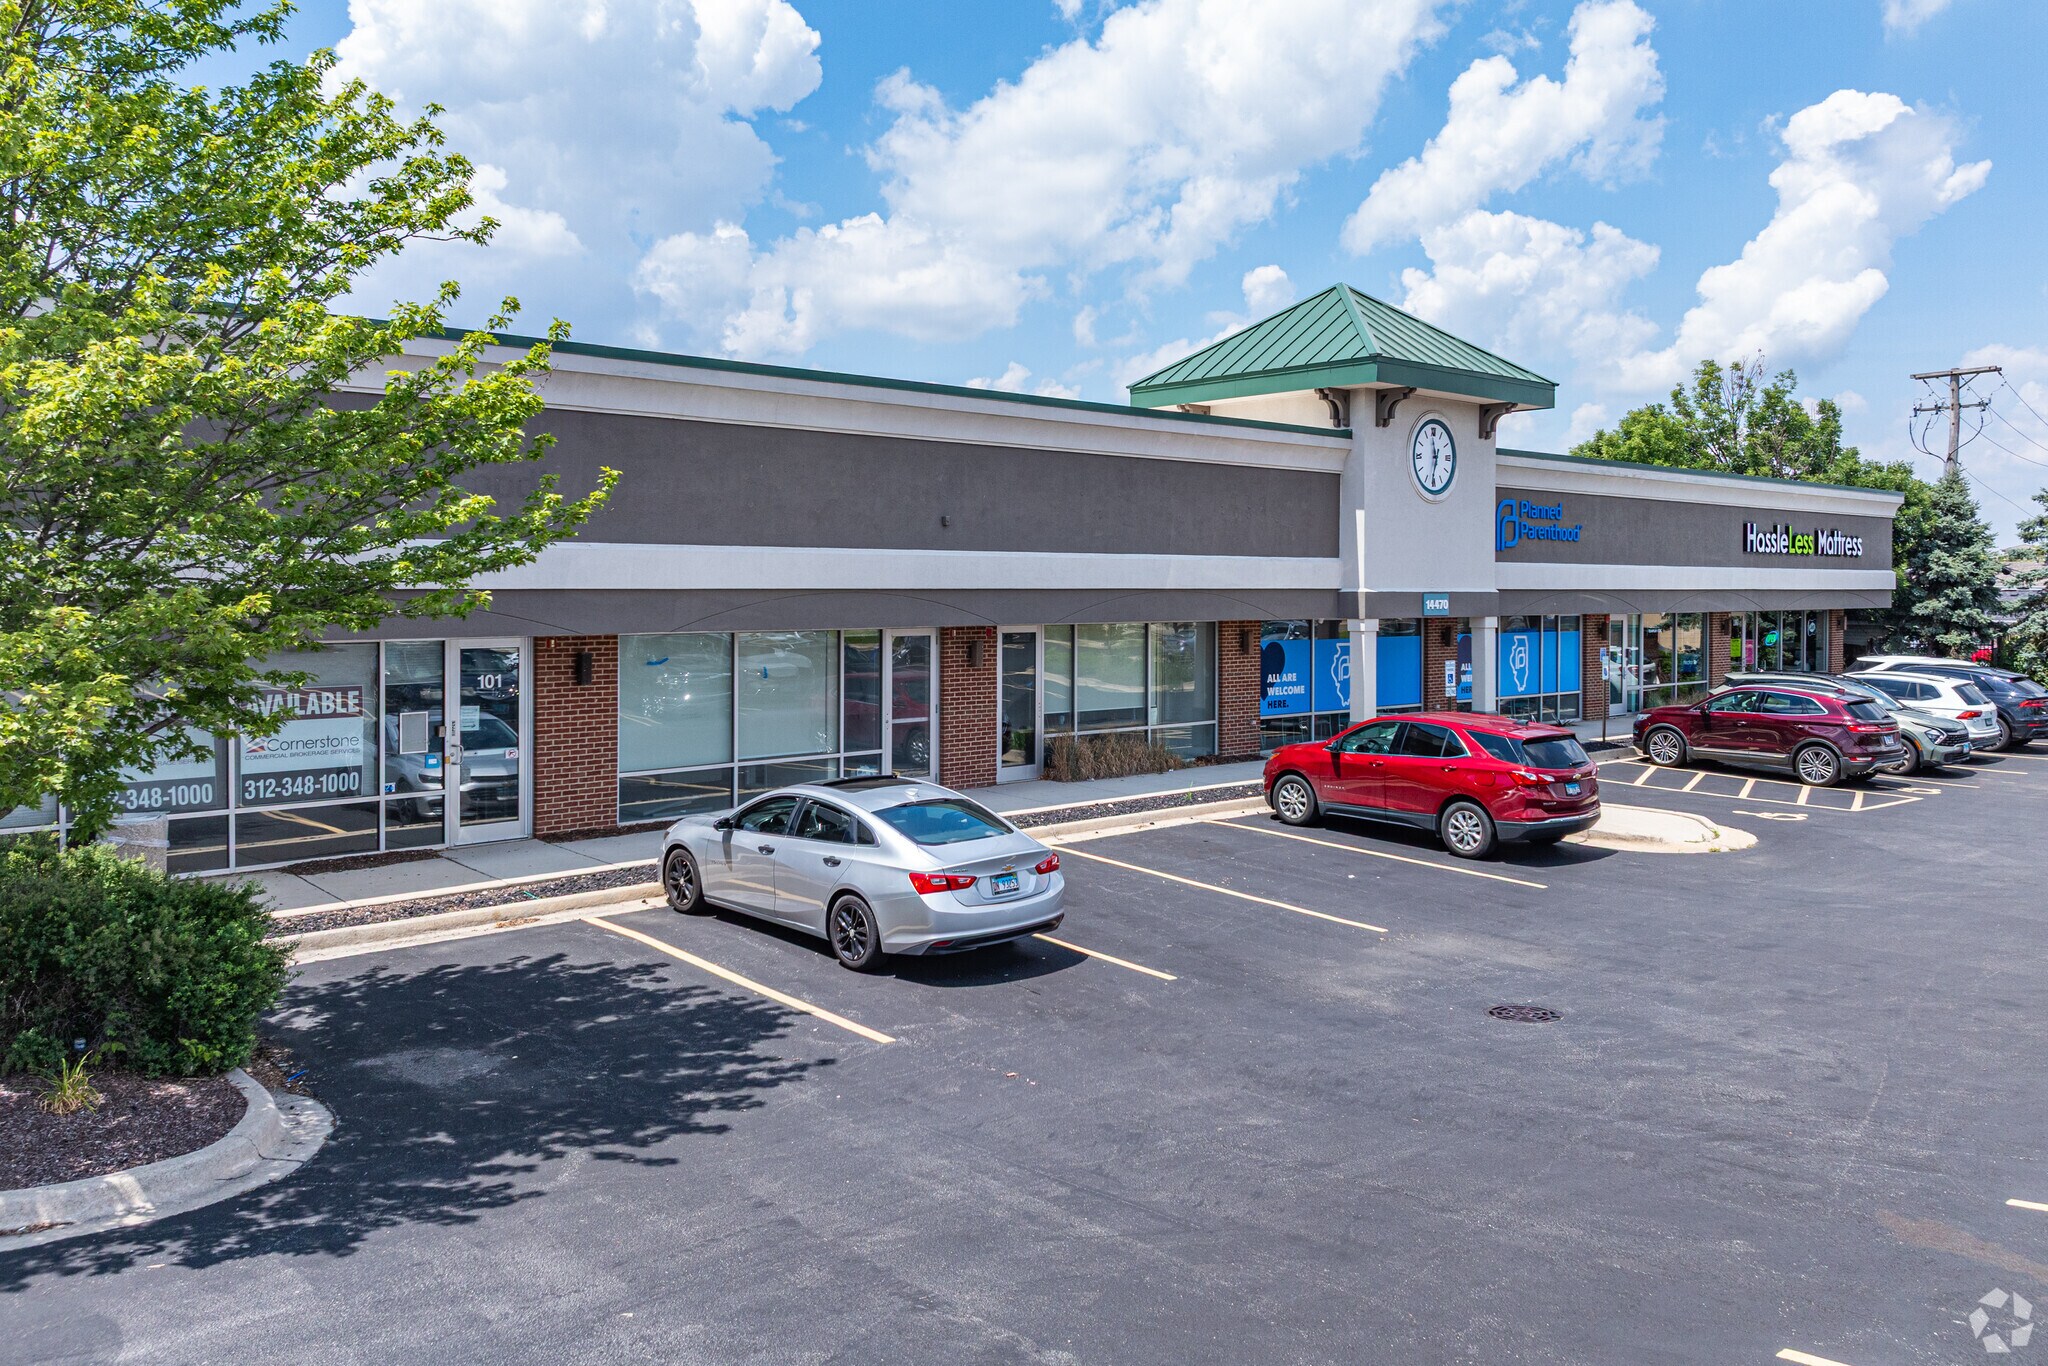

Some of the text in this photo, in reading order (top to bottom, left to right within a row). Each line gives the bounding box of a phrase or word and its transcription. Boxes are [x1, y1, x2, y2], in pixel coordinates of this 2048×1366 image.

[1520, 500, 1563, 520] Planned
[1519, 521, 1581, 542] Parenthood
[1745, 522, 1863, 557] HassleLess Mattress
[1425, 599, 1449, 610] 14470
[477, 674, 502, 689] 101
[1267, 673, 1297, 683] ALL ARE
[1267, 685, 1305, 696] WELCOME
[1267, 699, 1289, 709] HERE.
[267, 735, 360, 751] Cornerstone
[245, 747, 360, 761] COMMERCIAL BROKERAGE SERVICES
[244, 771, 359, 800] 312-348-1000
